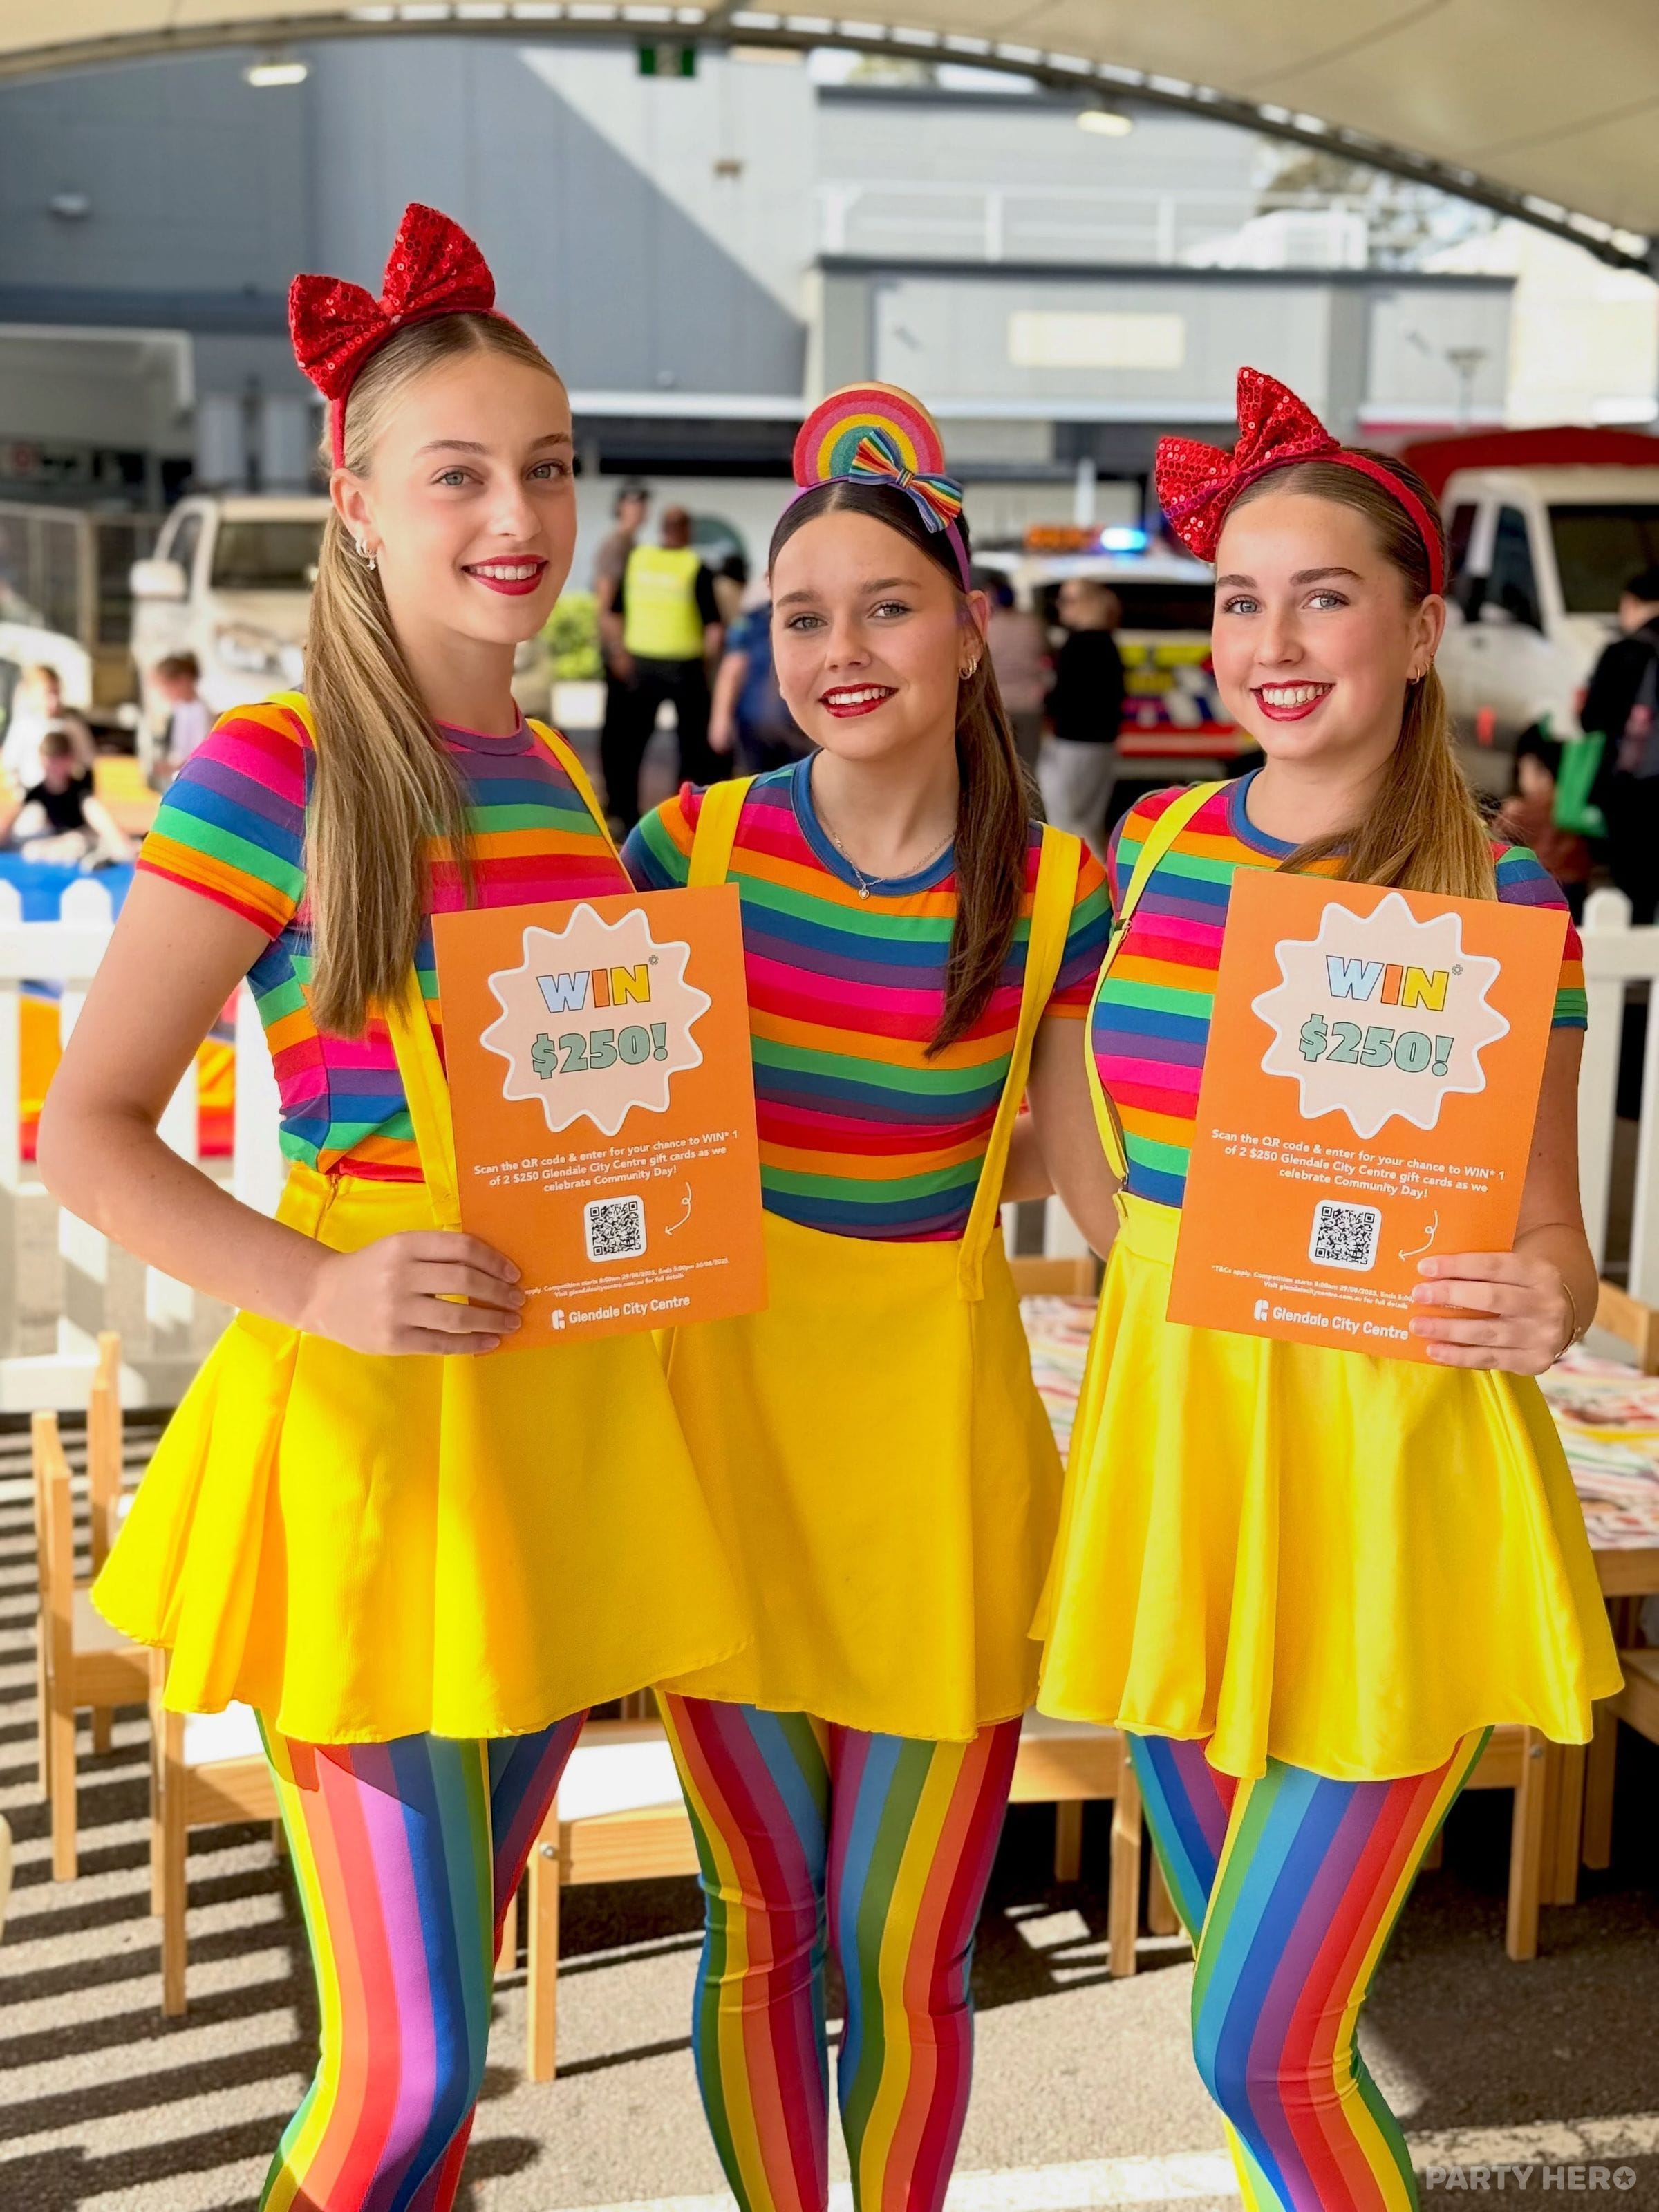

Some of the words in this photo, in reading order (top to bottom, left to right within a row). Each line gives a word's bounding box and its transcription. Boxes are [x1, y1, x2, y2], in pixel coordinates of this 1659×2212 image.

[531, 1022, 668, 1079] $250!
[1298, 1013, 1454, 1076] $250!
[474, 1165, 499, 1175] Scan
[500, 1161, 519, 1172] the
[521, 1157, 539, 1168] QR
[540, 1154, 565, 1166] code
[568, 1152, 578, 1163] &
[579, 1150, 607, 1161] enter
[609, 1147, 626, 1156] for
[627, 1145, 650, 1156] your
[652, 1139, 686, 1150] chance
[688, 1137, 700, 1146] to
[732, 1130, 738, 1139] 1
[489, 1175, 501, 1186] of
[503, 1174, 511, 1185] 2
[512, 1171, 539, 1183] $250
[541, 1164, 587, 1179] Glendale
[589, 1162, 610, 1173] City
[612, 1158, 647, 1169] Centre
[649, 1152, 668, 1167] gift
[669, 1149, 697, 1161] cards
[697, 1149, 710, 1157] as
[711, 1147, 727, 1155] we
[1211, 1128, 1237, 1142] Scan
[1239, 1133, 1259, 1145] the
[1262, 1136, 1280, 1147] QR
[1282, 1141, 1310, 1152] code
[1313, 1143, 1322, 1154] &
[1325, 1148, 1356, 1159] enter
[1358, 1150, 1376, 1162] for
[1377, 1156, 1405, 1166] your
[1407, 1158, 1445, 1172] chance
[1448, 1164, 1461, 1175] to
[1498, 1170, 1505, 1181] 1
[1224, 1145, 1238, 1155] of
[1239, 1146, 1247, 1157] 2
[1249, 1147, 1278, 1161] $250
[1280, 1153, 1330, 1170] Glendale
[1333, 1161, 1356, 1176] City
[1358, 1165, 1396, 1179] Centre
[1399, 1172, 1421, 1183] gift
[1423, 1177, 1453, 1188] cards
[1455, 1181, 1468, 1190] as
[1470, 1183, 1488, 1192] we
[543, 1179, 591, 1192] celebrate
[594, 1170, 651, 1185] Community
[653, 1165, 677, 1178] Day!
[1279, 1168, 1331, 1183] celebrate
[1334, 1175, 1398, 1196] Community
[1400, 1184, 1427, 1200] Day!
[569, 1306, 619, 1323] Glendale
[623, 1302, 648, 1315] City
[650, 1297, 690, 1311] Centre
[1273, 1307, 1329, 1327] Glendale
[1332, 1316, 1360, 1334] City
[1363, 1321, 1408, 1340] Centre
